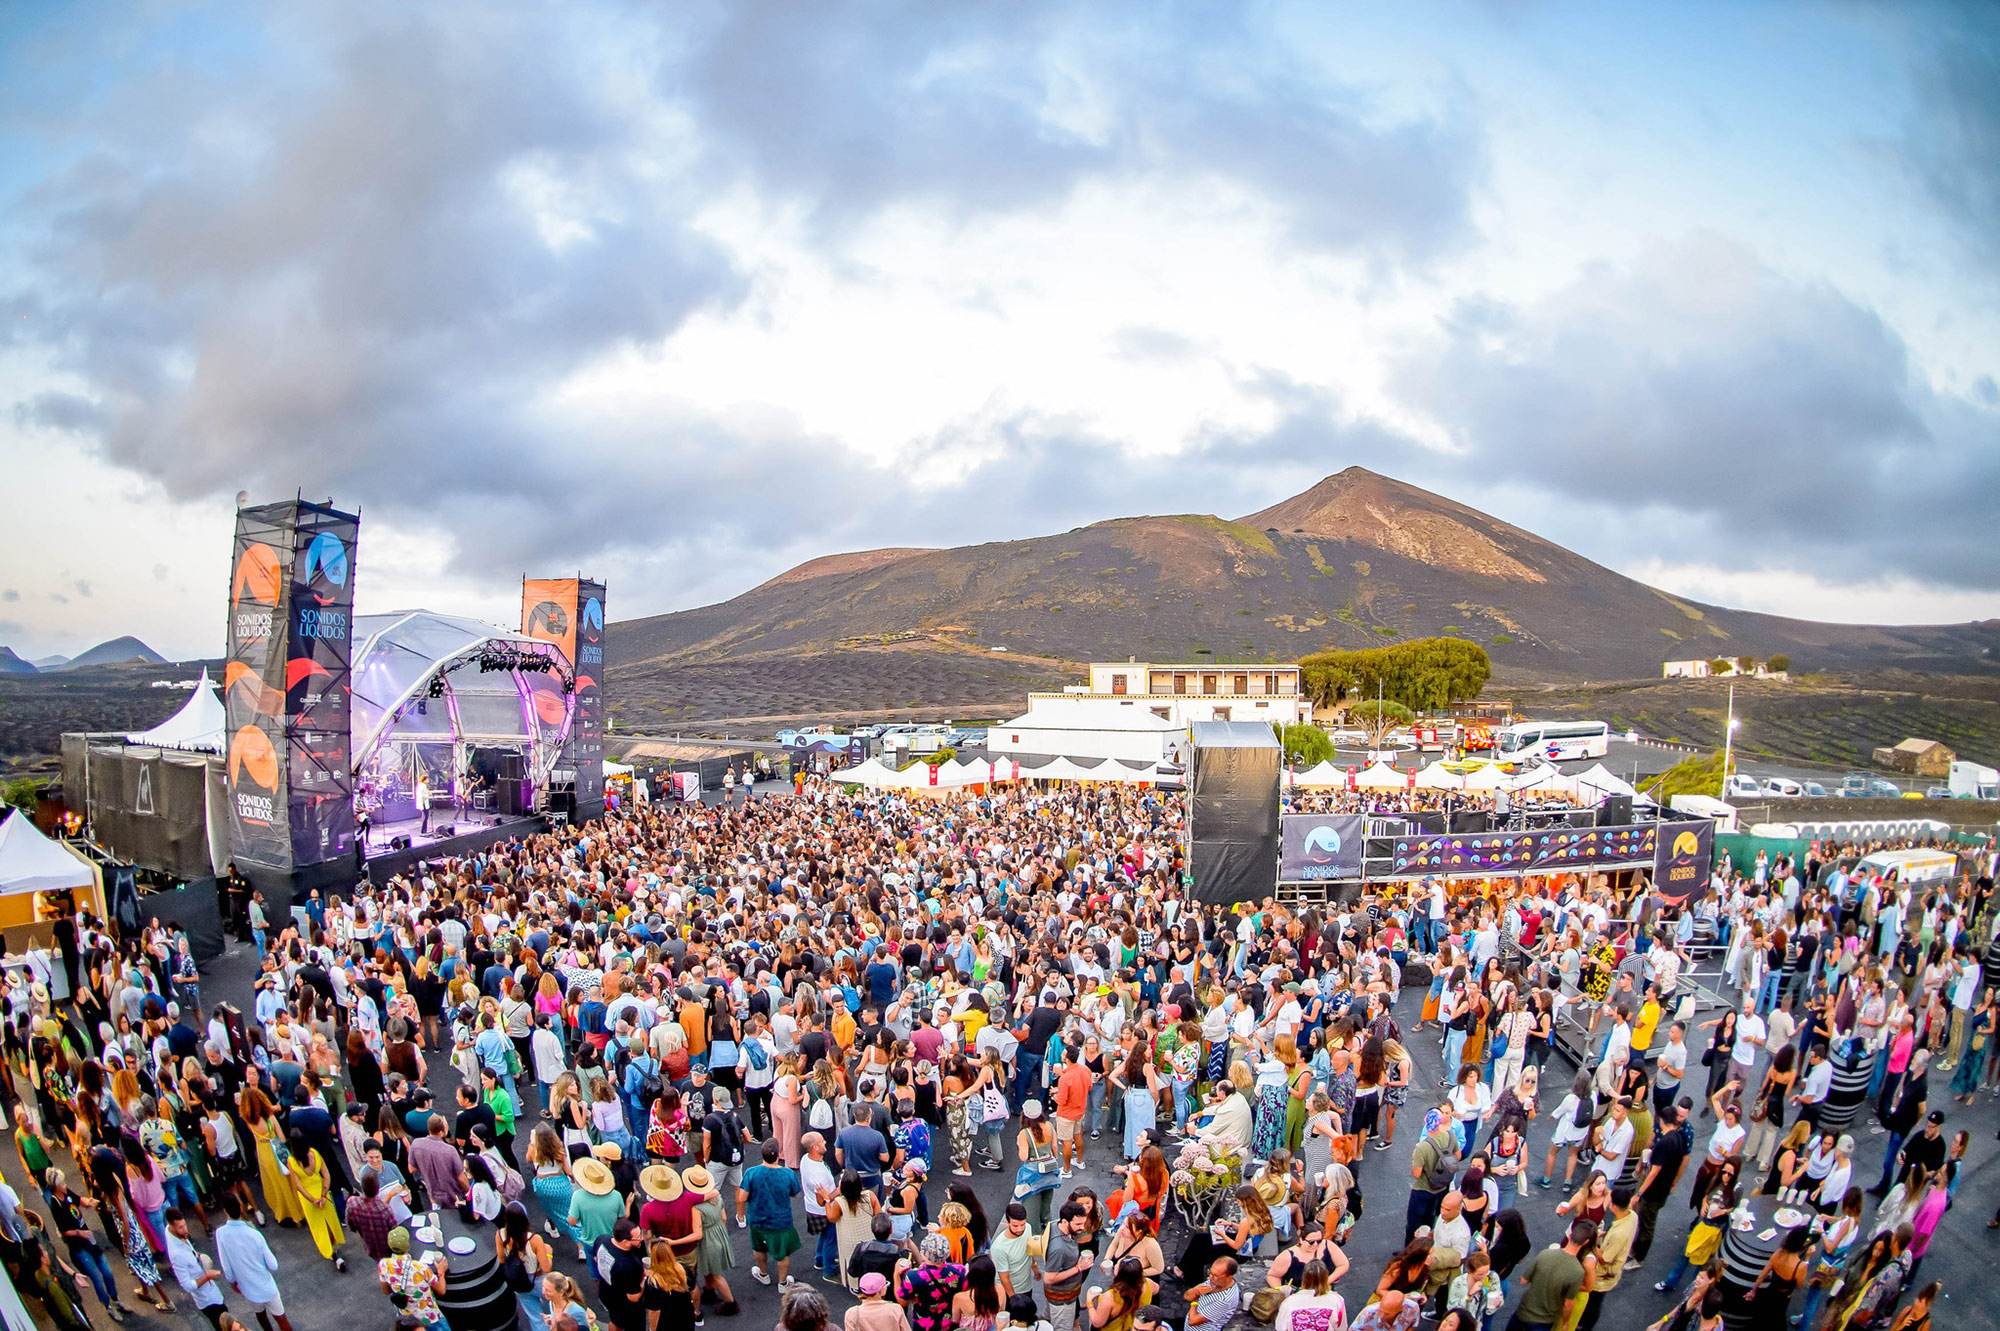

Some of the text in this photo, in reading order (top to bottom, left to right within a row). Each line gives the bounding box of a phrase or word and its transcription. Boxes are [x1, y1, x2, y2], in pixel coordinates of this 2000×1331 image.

[237, 613, 273, 626] SONIDOS
[301, 609, 346, 626] SONIDOS
[237, 793, 273, 809] SONIDOS
